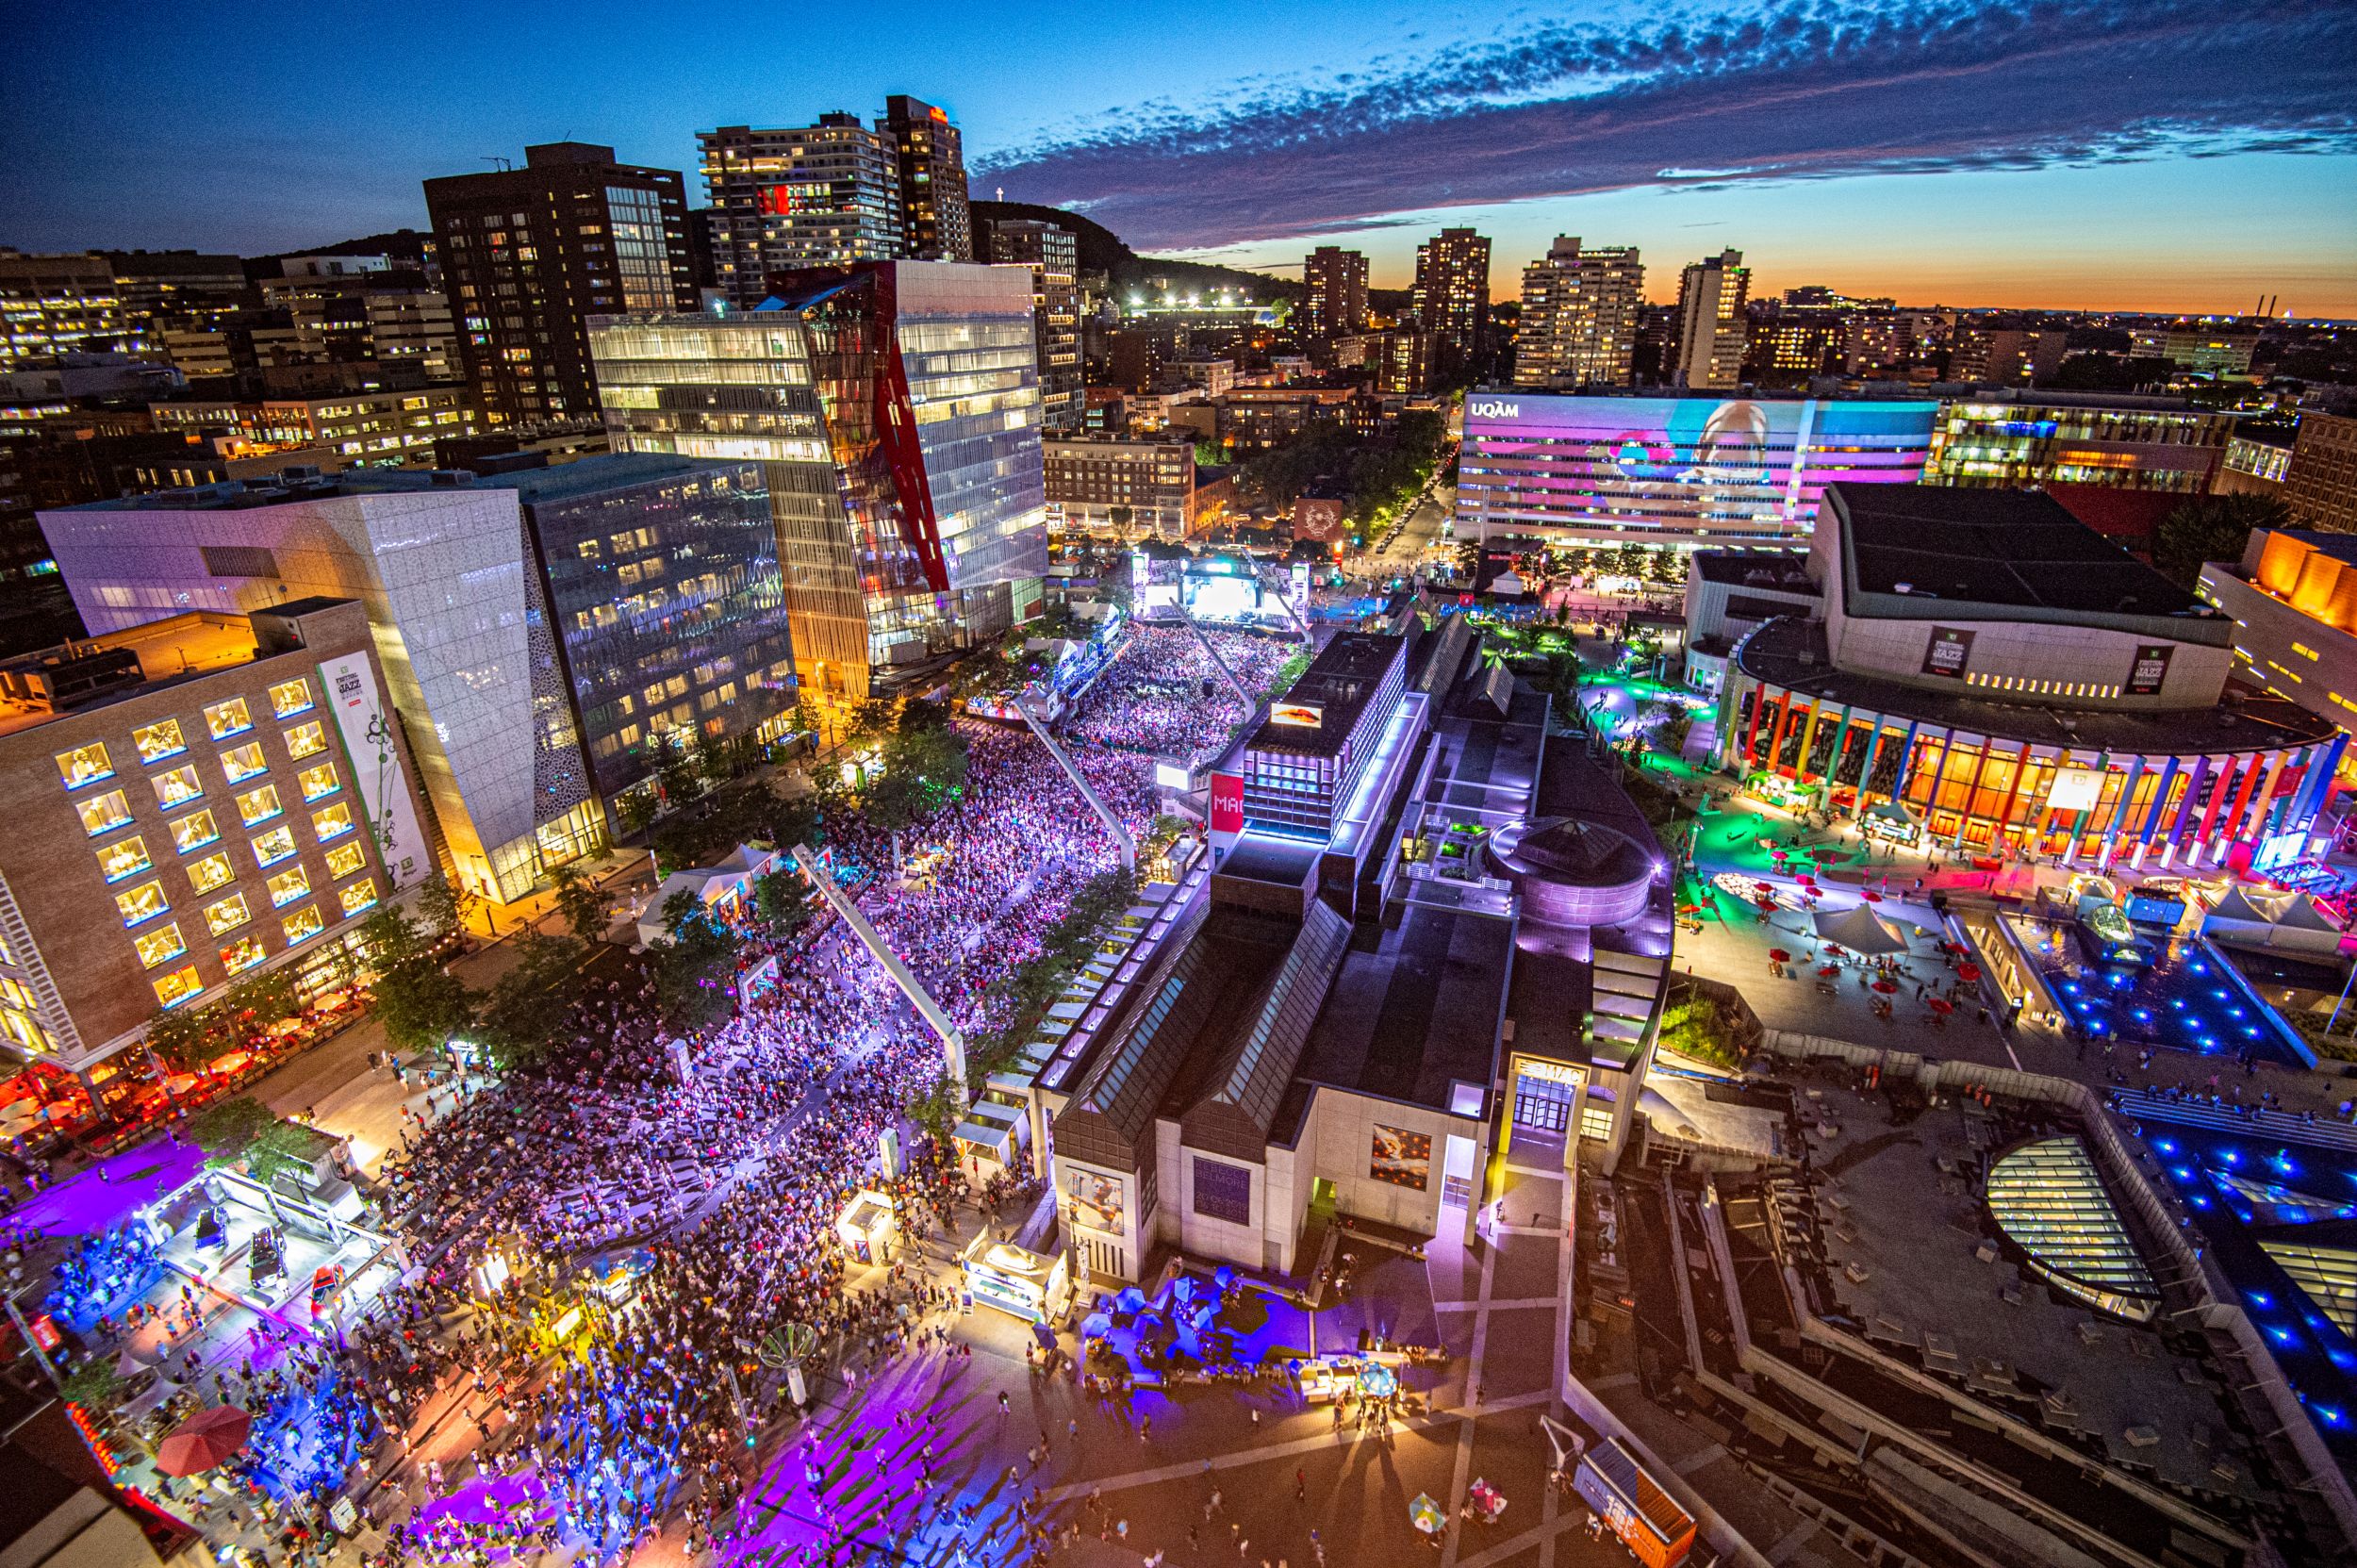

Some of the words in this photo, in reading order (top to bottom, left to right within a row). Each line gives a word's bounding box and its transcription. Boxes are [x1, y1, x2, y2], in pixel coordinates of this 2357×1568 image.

[1472, 401, 1519, 419] UQÀM
[1933, 649, 1963, 662] JAZZ
[2135, 667, 2163, 678] JAZZ
[338, 679, 362, 694] JAZZ
[1544, 1065, 1580, 1083] MAC
[1195, 1159, 1247, 1180] REBECCA
[1195, 1168, 1247, 1189] BELMORE
